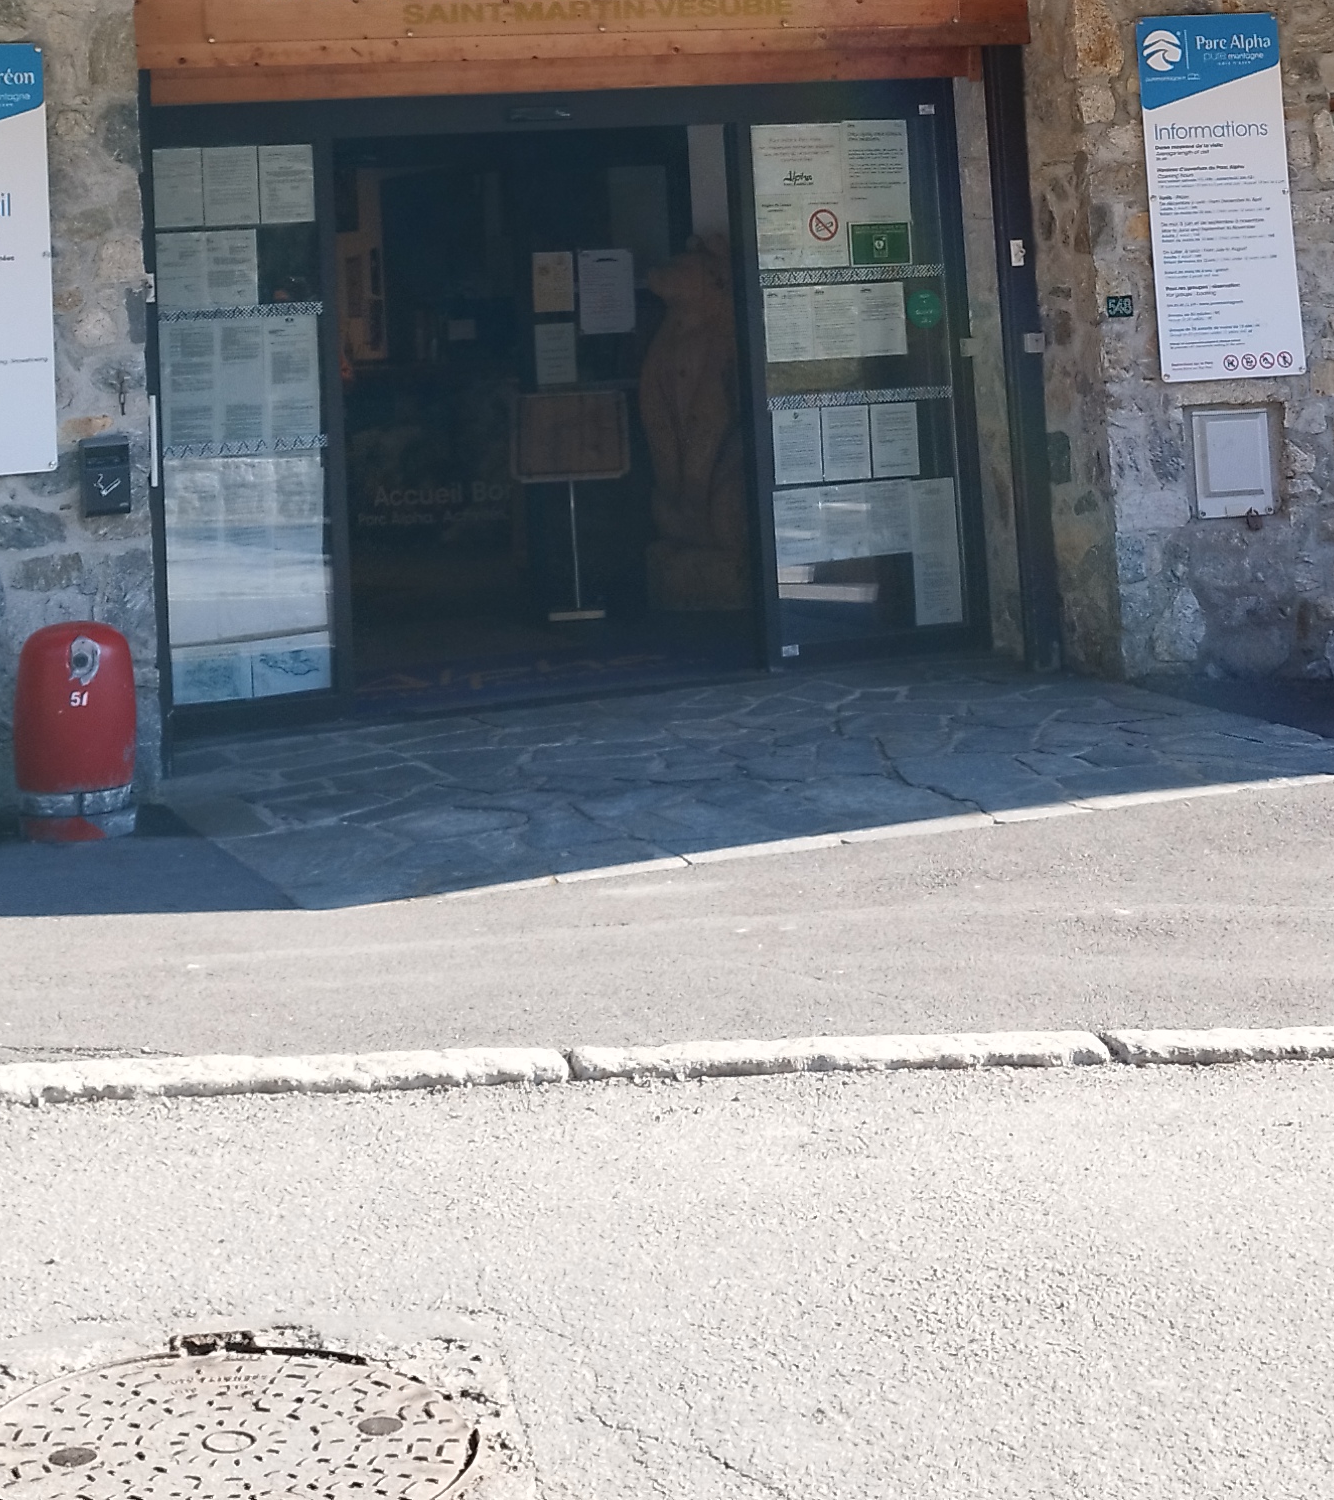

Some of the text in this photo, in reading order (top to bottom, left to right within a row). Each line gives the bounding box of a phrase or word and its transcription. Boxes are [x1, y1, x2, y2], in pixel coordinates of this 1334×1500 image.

[1195, 33, 1271, 53] Parc Alpha
[1228, 52, 1264, 61] montagne
[1154, 120, 1268, 140] Informations
[70, 691, 89, 707] 51
